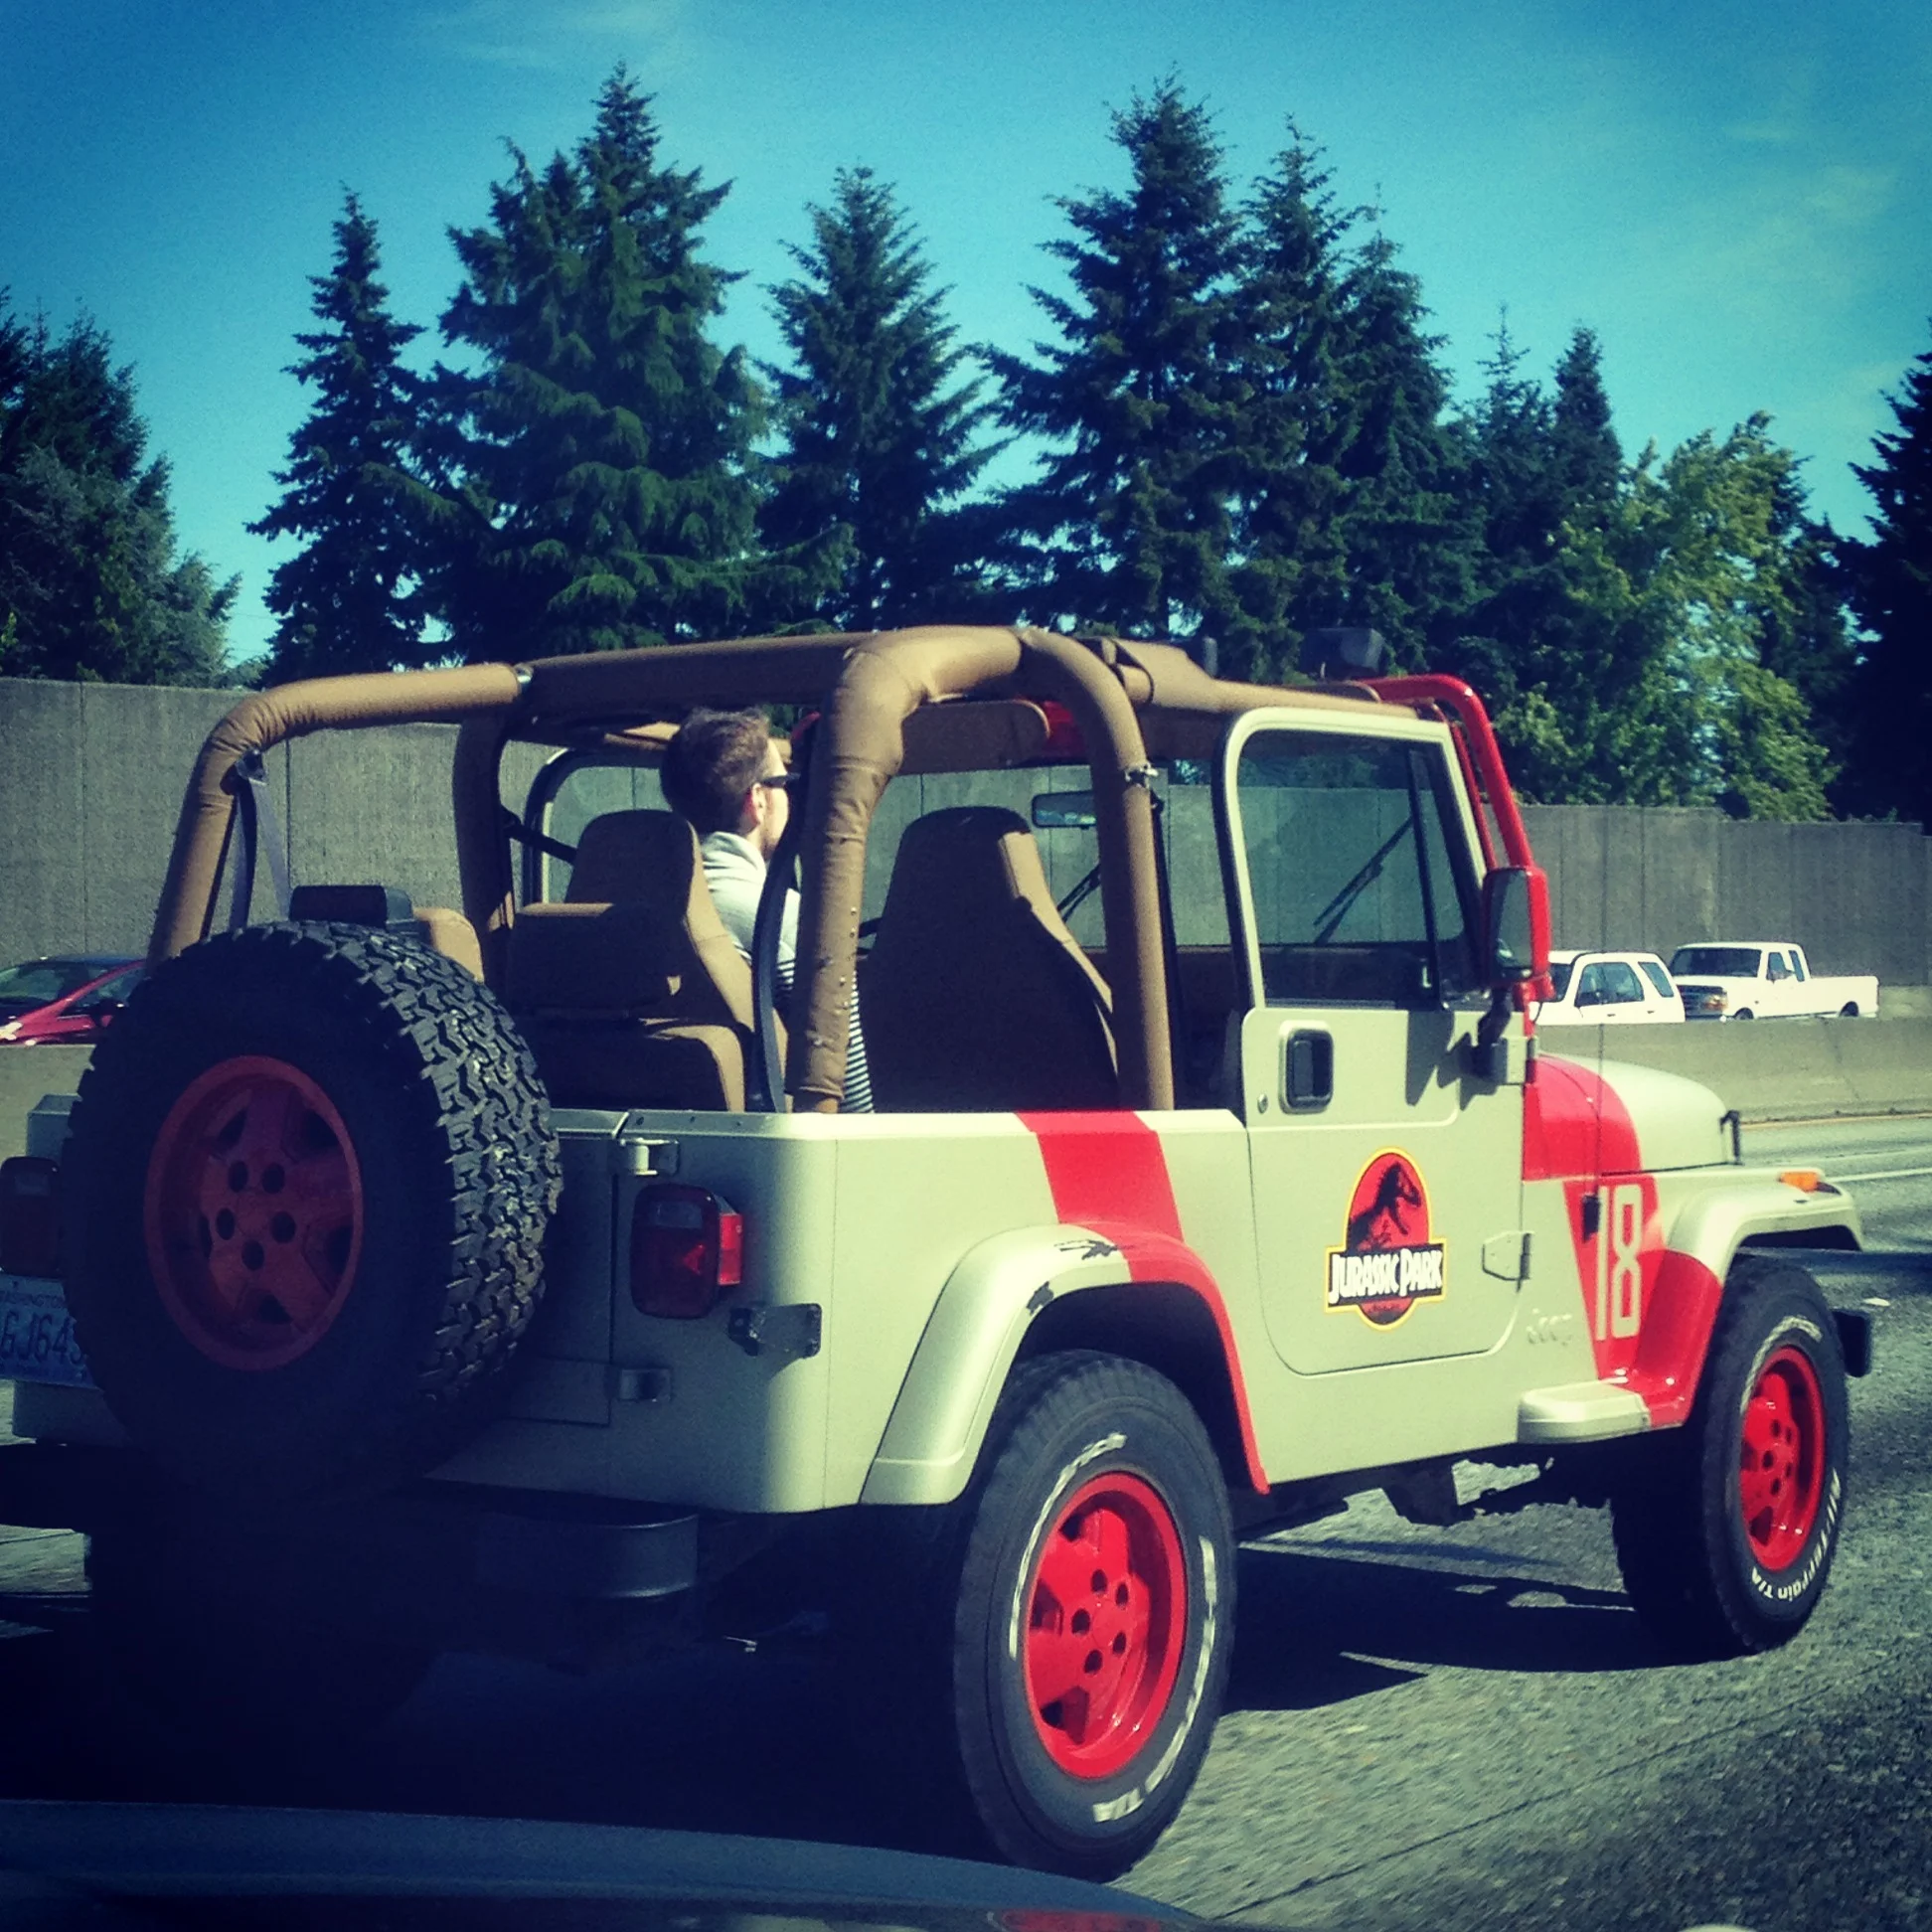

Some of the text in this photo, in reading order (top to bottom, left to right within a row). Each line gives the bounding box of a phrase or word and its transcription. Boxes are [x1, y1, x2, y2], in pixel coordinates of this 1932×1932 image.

[1328, 1248, 1443, 1304] JURASSIC PARK
[1595, 1184, 1643, 1341] 18
